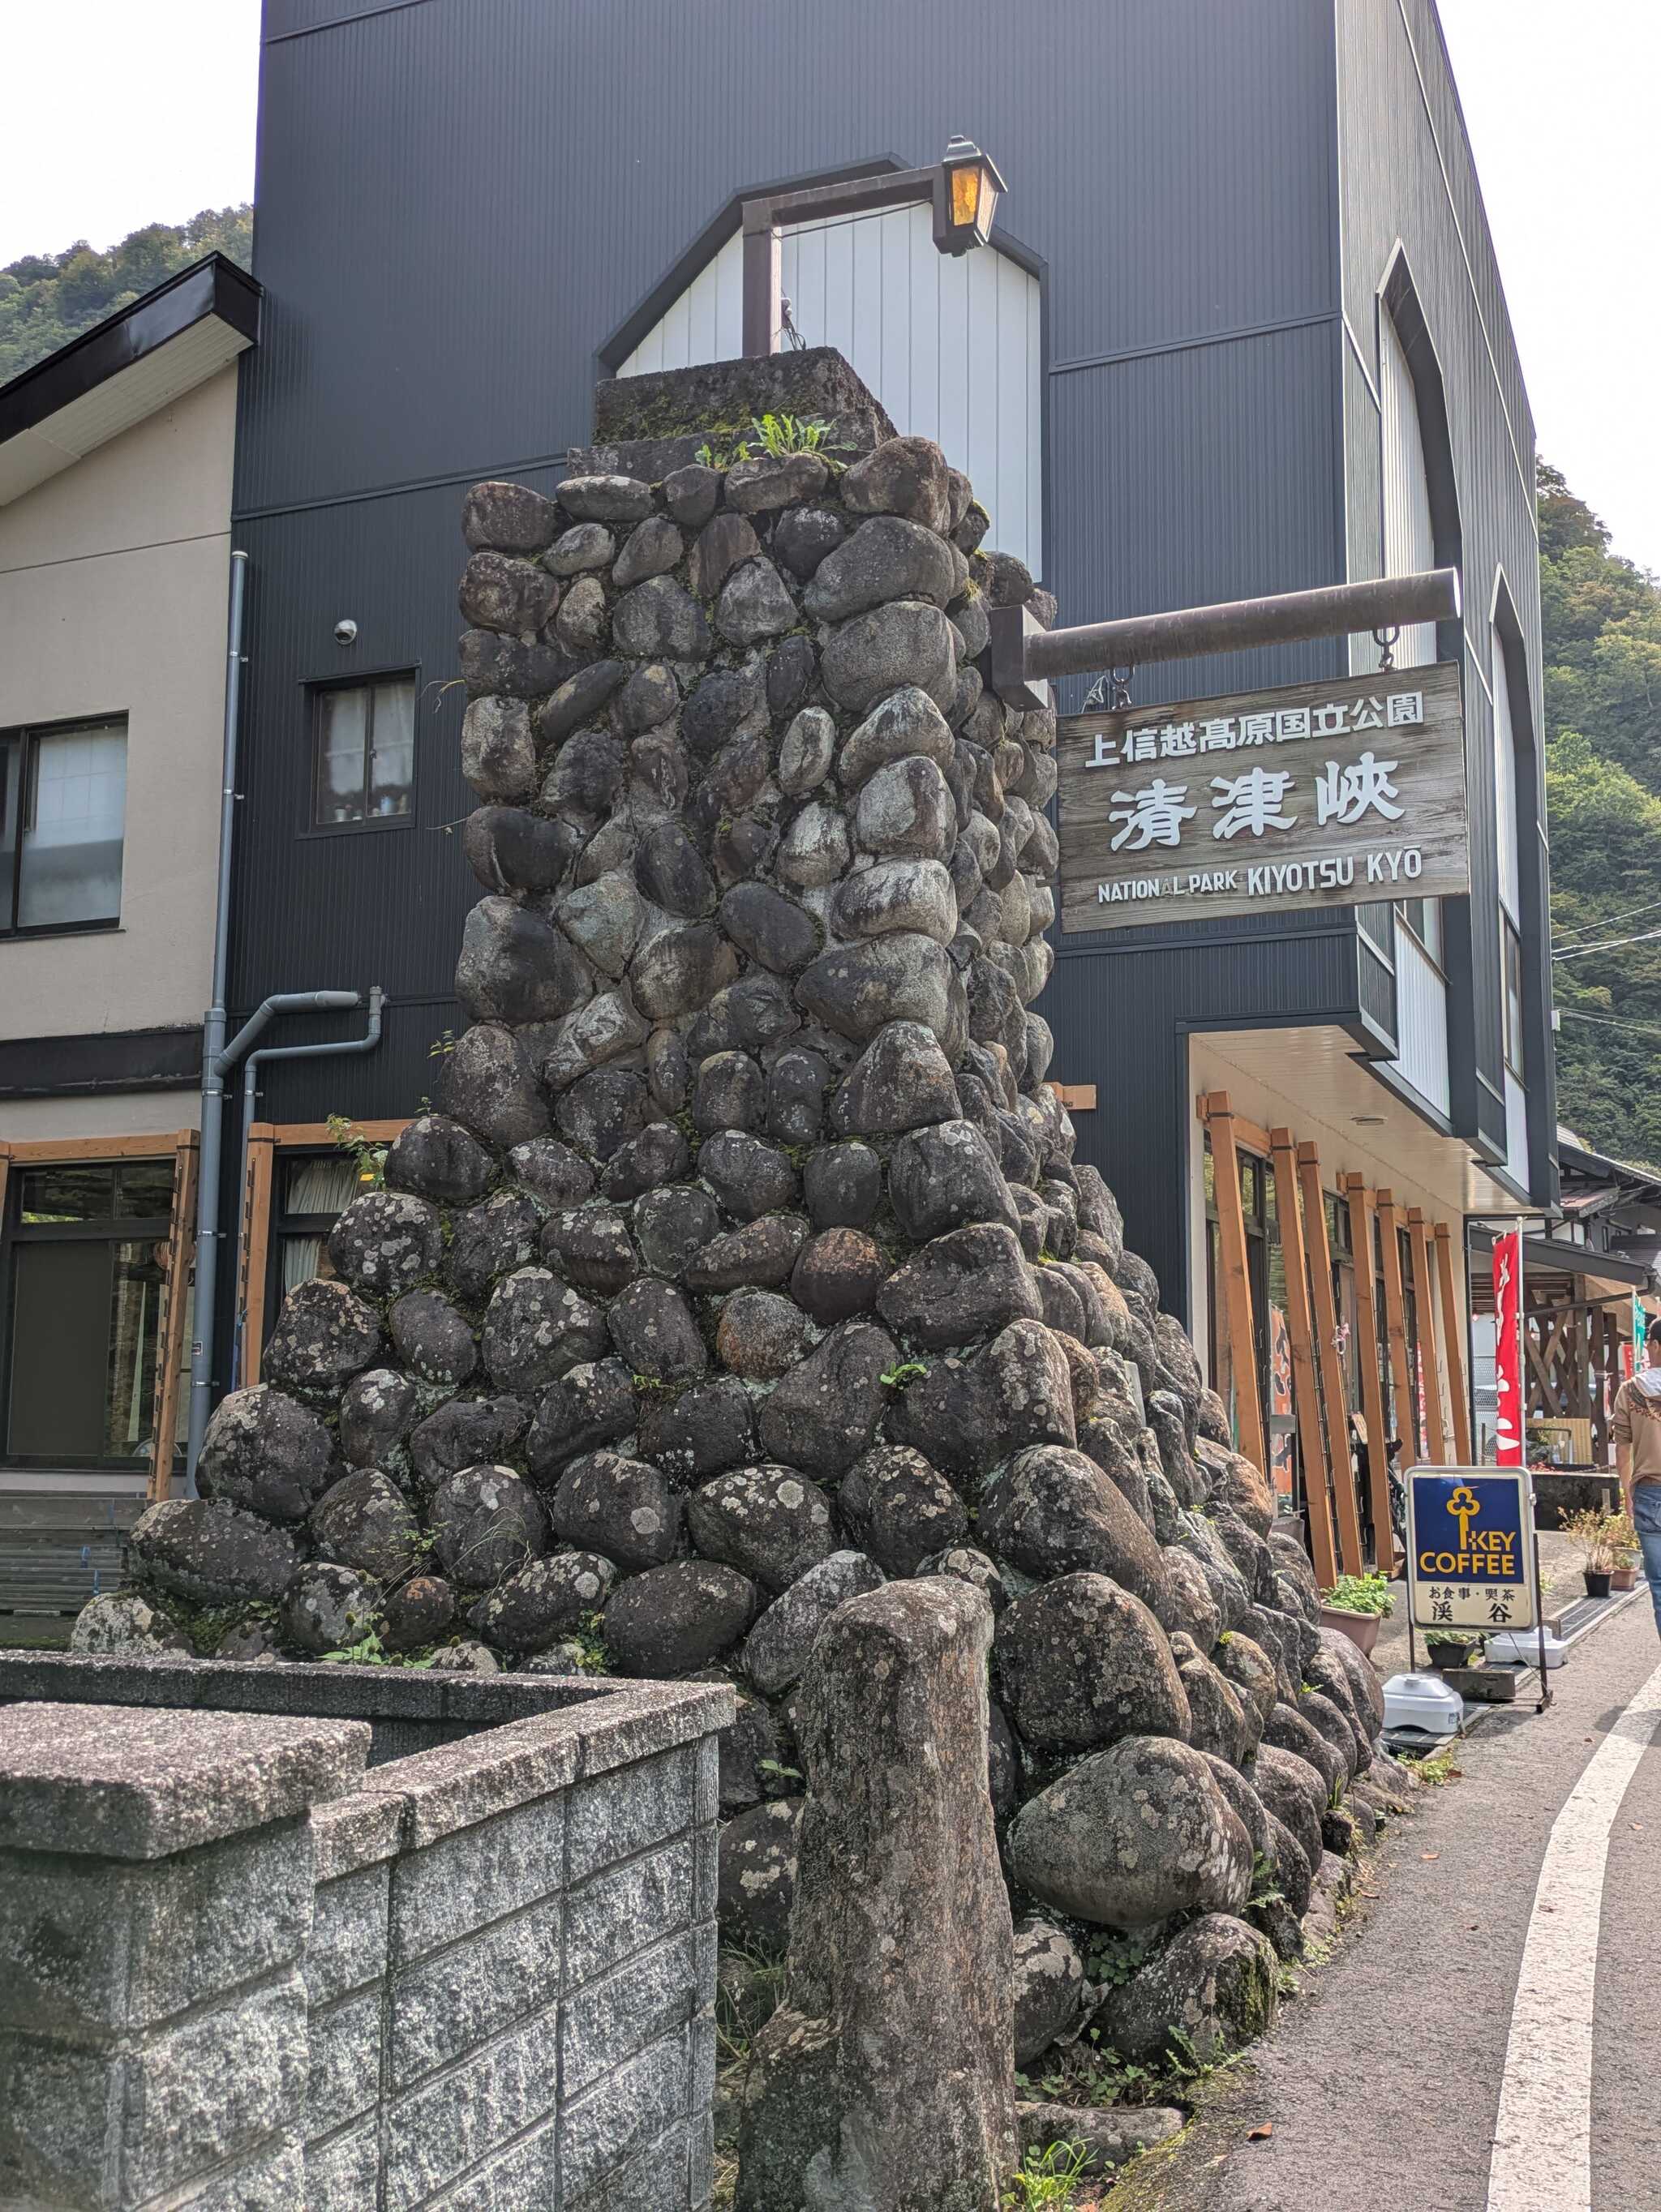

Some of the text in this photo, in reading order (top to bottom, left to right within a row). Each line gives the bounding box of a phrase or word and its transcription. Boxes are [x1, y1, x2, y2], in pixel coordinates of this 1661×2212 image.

[1188, 869, 1238, 893] PARK
[1247, 856, 1354, 896] KIYOTSU
[1467, 1531, 1516, 1551] KEY
[1420, 1552, 1515, 1575] COFFEE
[1429, 1586, 1515, 1601] お食事・喫茶
